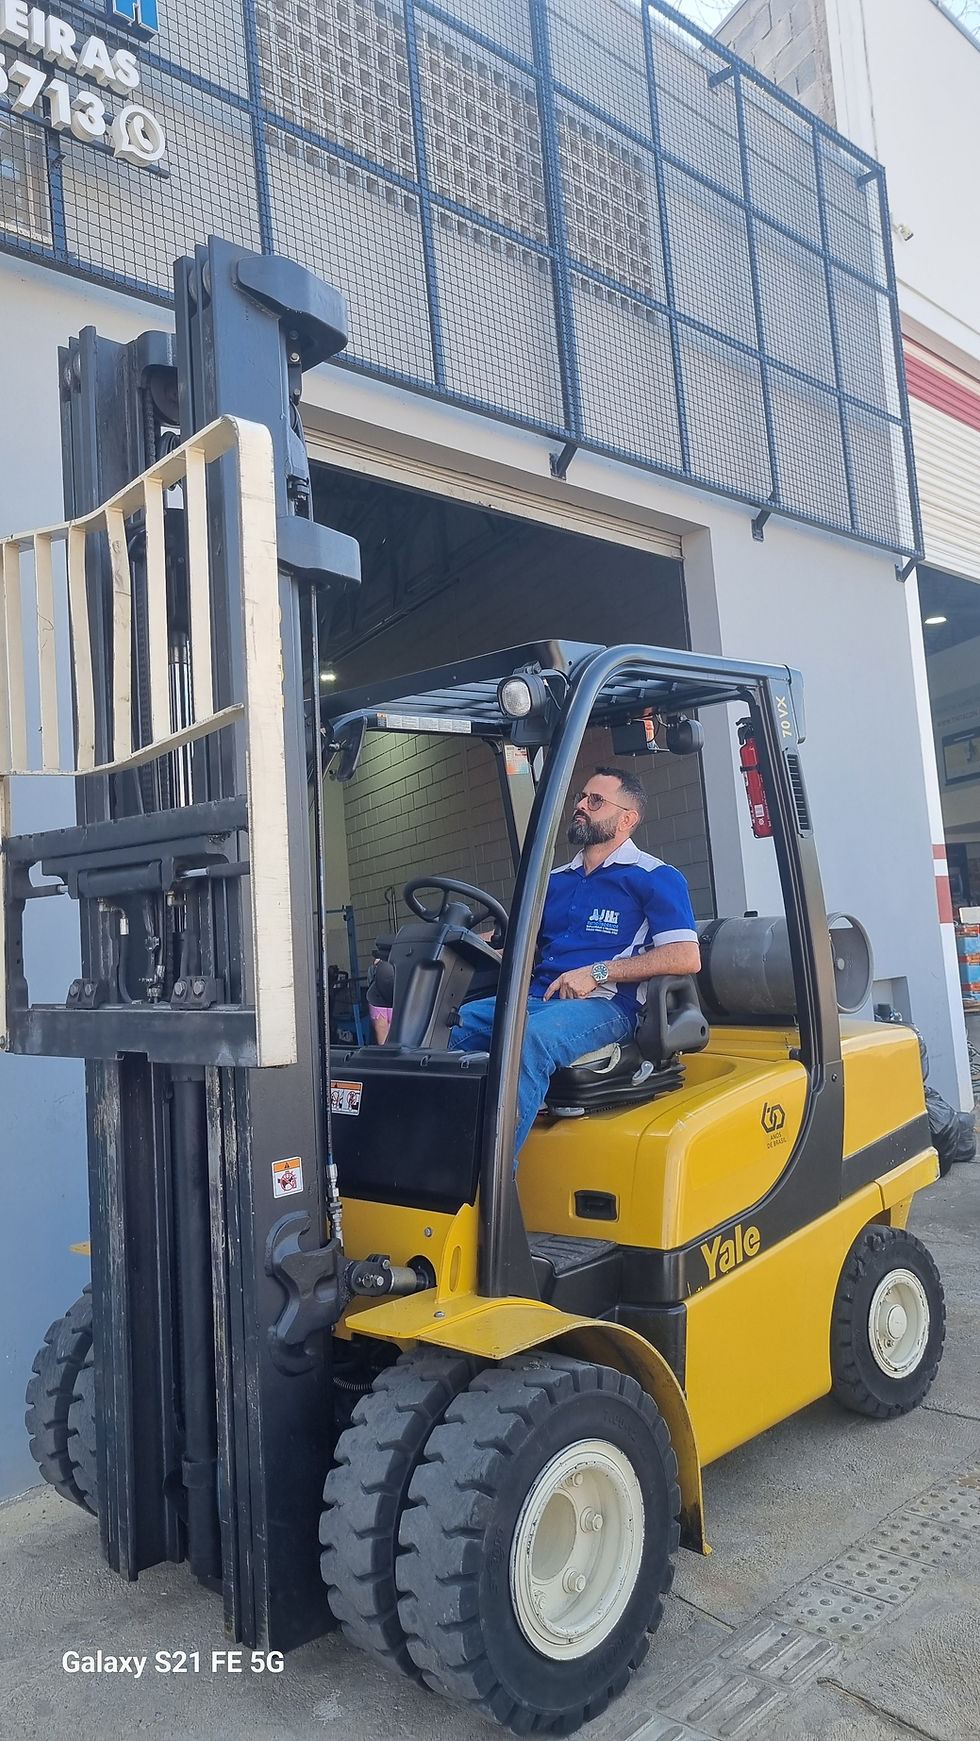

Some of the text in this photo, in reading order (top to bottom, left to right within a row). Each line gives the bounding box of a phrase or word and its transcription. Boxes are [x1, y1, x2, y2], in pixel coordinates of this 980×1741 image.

[0, 53, 106, 141] 713
[775, 696, 792, 738] 70 VX
[773, 1137, 787, 1146] BRASIL
[701, 1224, 760, 1280] Yale
